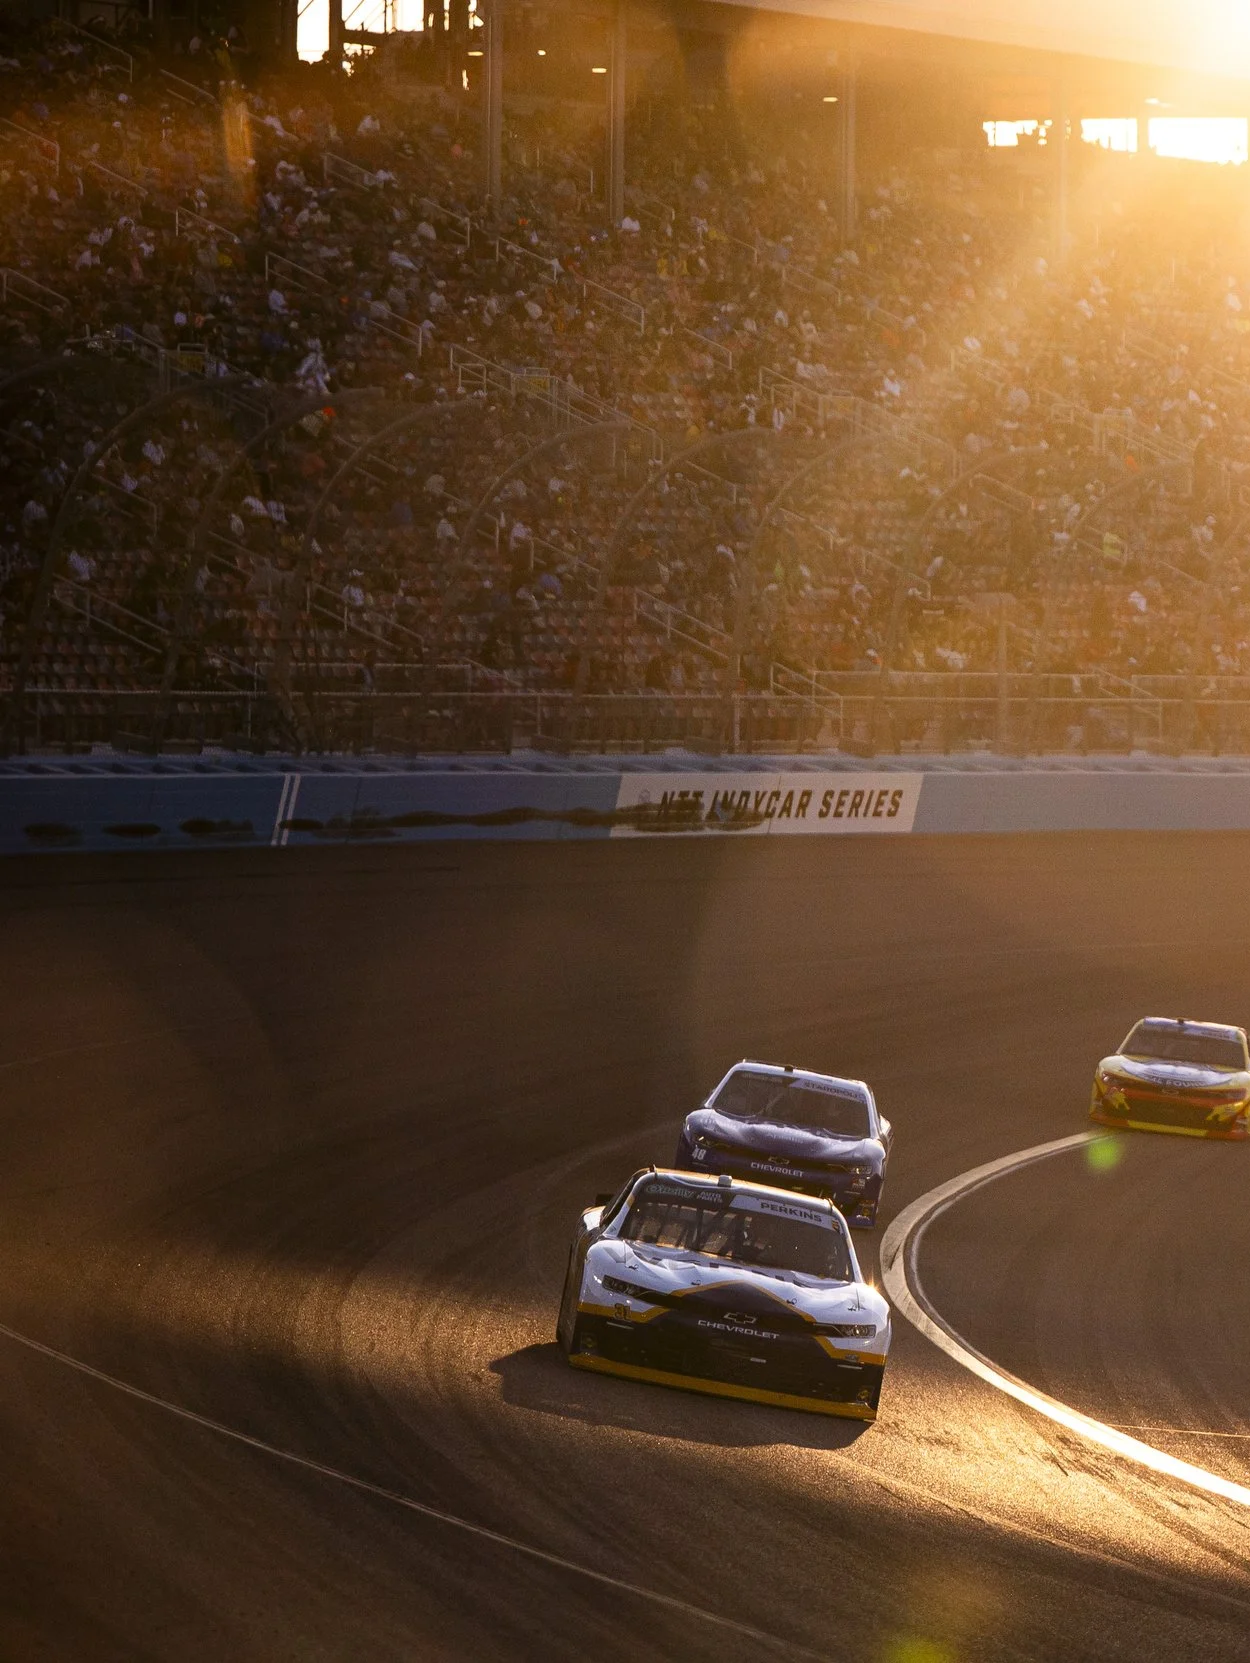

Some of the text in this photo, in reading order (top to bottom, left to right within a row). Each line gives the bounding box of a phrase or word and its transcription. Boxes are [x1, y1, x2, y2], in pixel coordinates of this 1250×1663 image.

[704, 790, 813, 819] INDYCAR
[818, 789, 904, 818] SERIES
[750, 1161, 805, 1178] CHEVROLET
[760, 1202, 823, 1222] PERKINS
[697, 1319, 780, 1340] CHEVROLET
